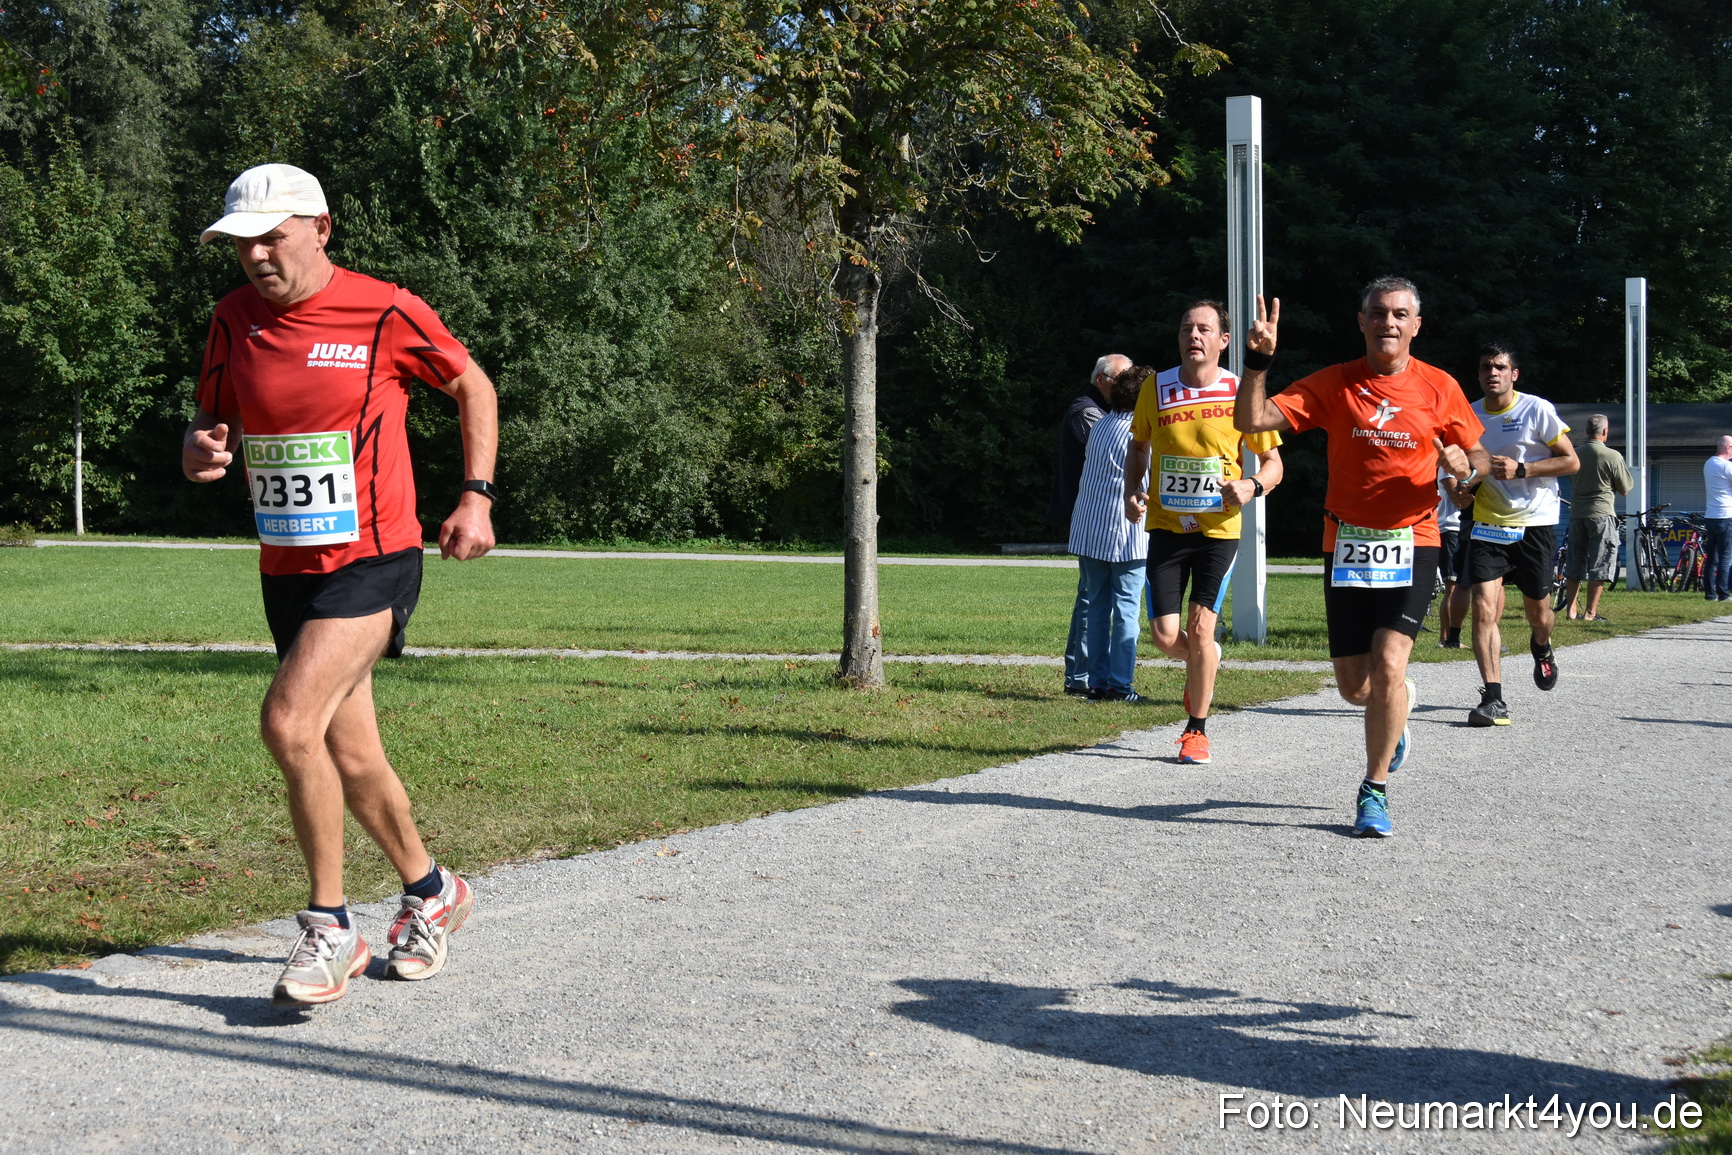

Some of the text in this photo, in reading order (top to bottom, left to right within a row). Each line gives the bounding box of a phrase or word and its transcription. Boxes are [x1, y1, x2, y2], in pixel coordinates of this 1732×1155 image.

[307, 343, 368, 361] JURA
[306, 360, 367, 369] SPORT-Service
[1158, 405, 1235, 427] MAX BÖG
[1352, 427, 1411, 440] funrunners
[248, 437, 342, 464] BOCK
[1368, 438, 1418, 449] neumarkt
[1164, 458, 1217, 472] BOCK
[256, 473, 336, 507] 2331
[1166, 475, 1215, 493] 2374
[1168, 498, 1213, 506] ANDREAS
[264, 516, 338, 533] HERBERT
[1343, 543, 1402, 564] 2301
[1347, 570, 1396, 580] ROBERT
